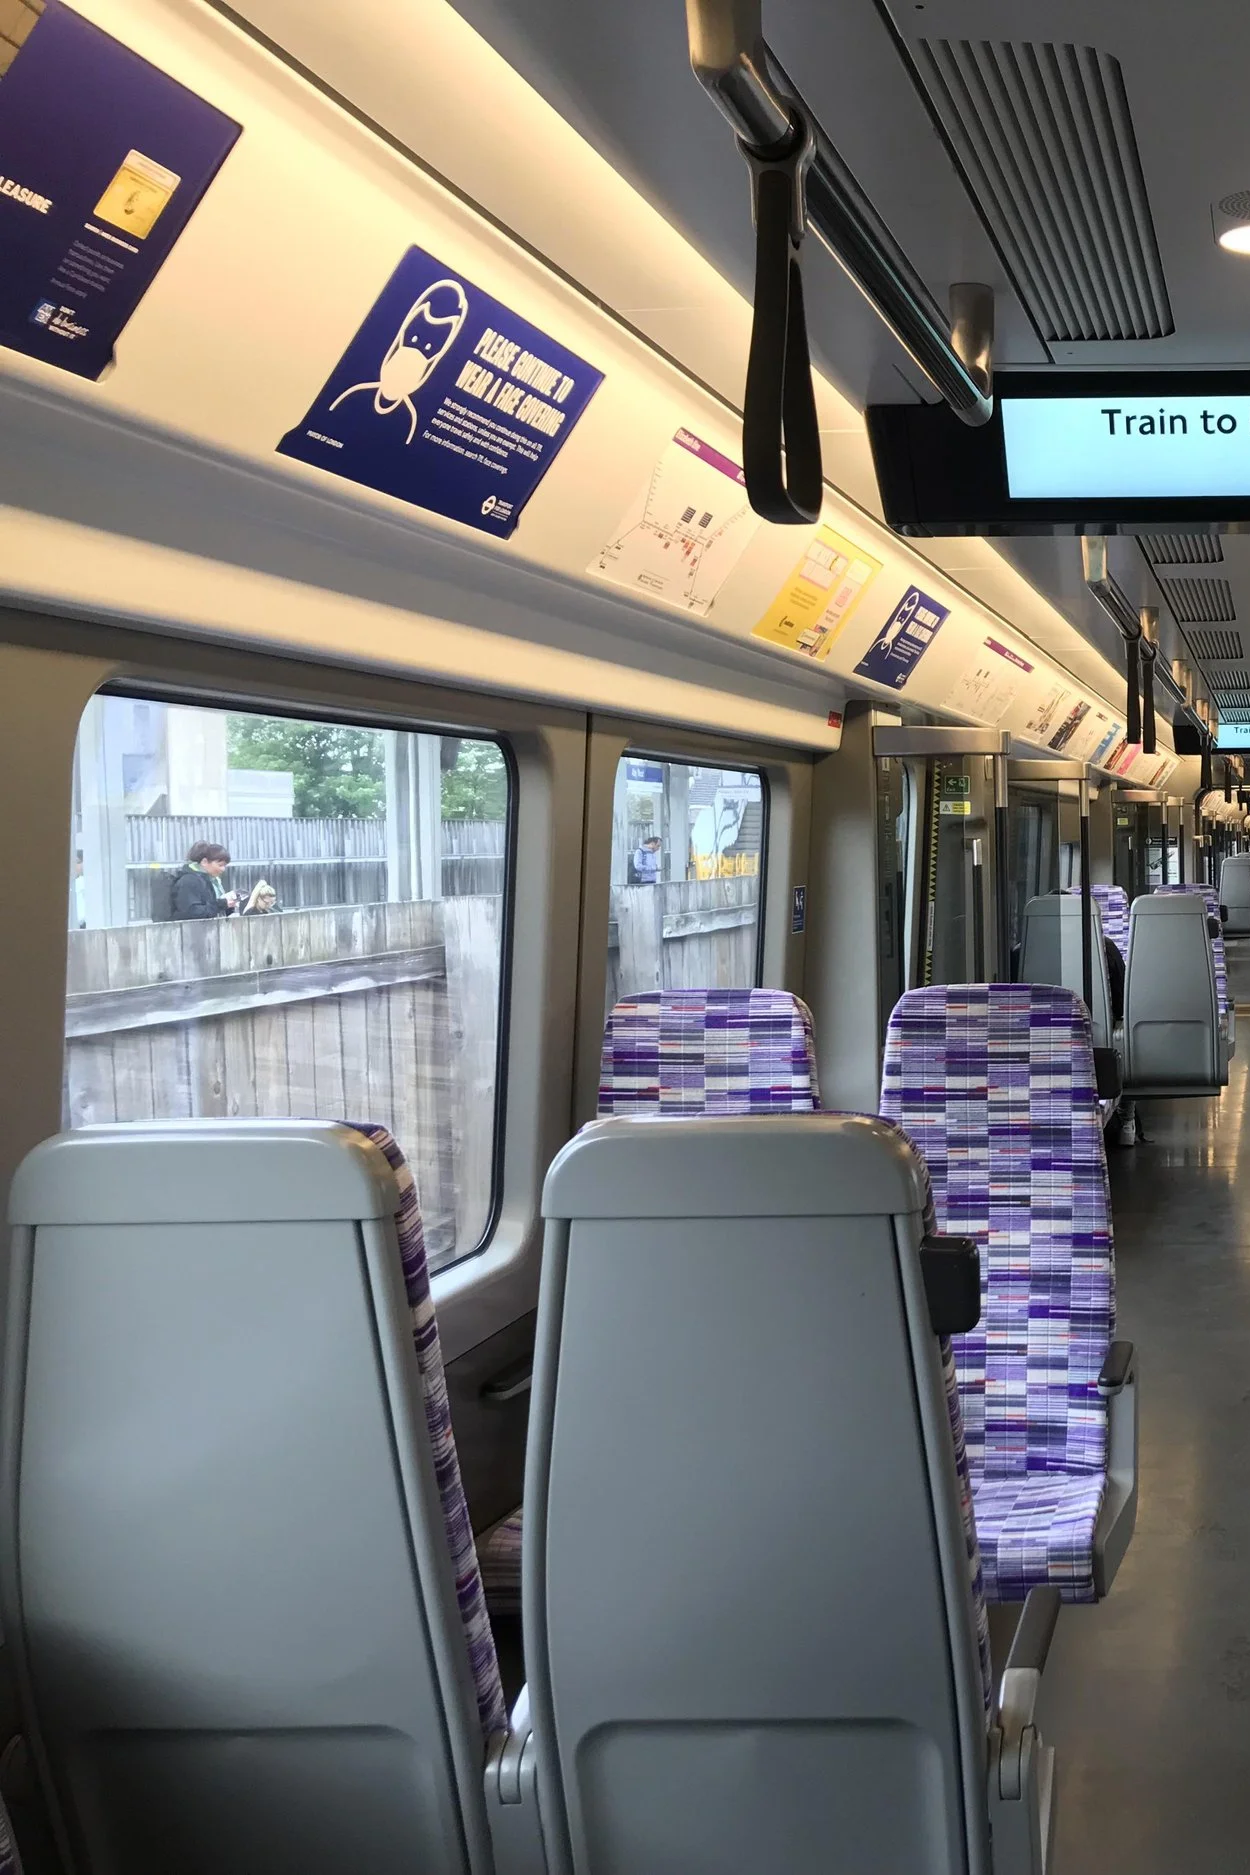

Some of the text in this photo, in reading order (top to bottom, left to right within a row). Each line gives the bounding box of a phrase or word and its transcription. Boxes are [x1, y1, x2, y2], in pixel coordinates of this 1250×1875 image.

[475, 329, 574, 402] PLEASE CONTINUE TO
[456, 361, 564, 436] WEAR A FACE COVERING
[1101, 408, 1187, 435] Train
[1200, 410, 1247, 434] to
[423, 430, 432, 438] For
[430, 435, 442, 444] more
